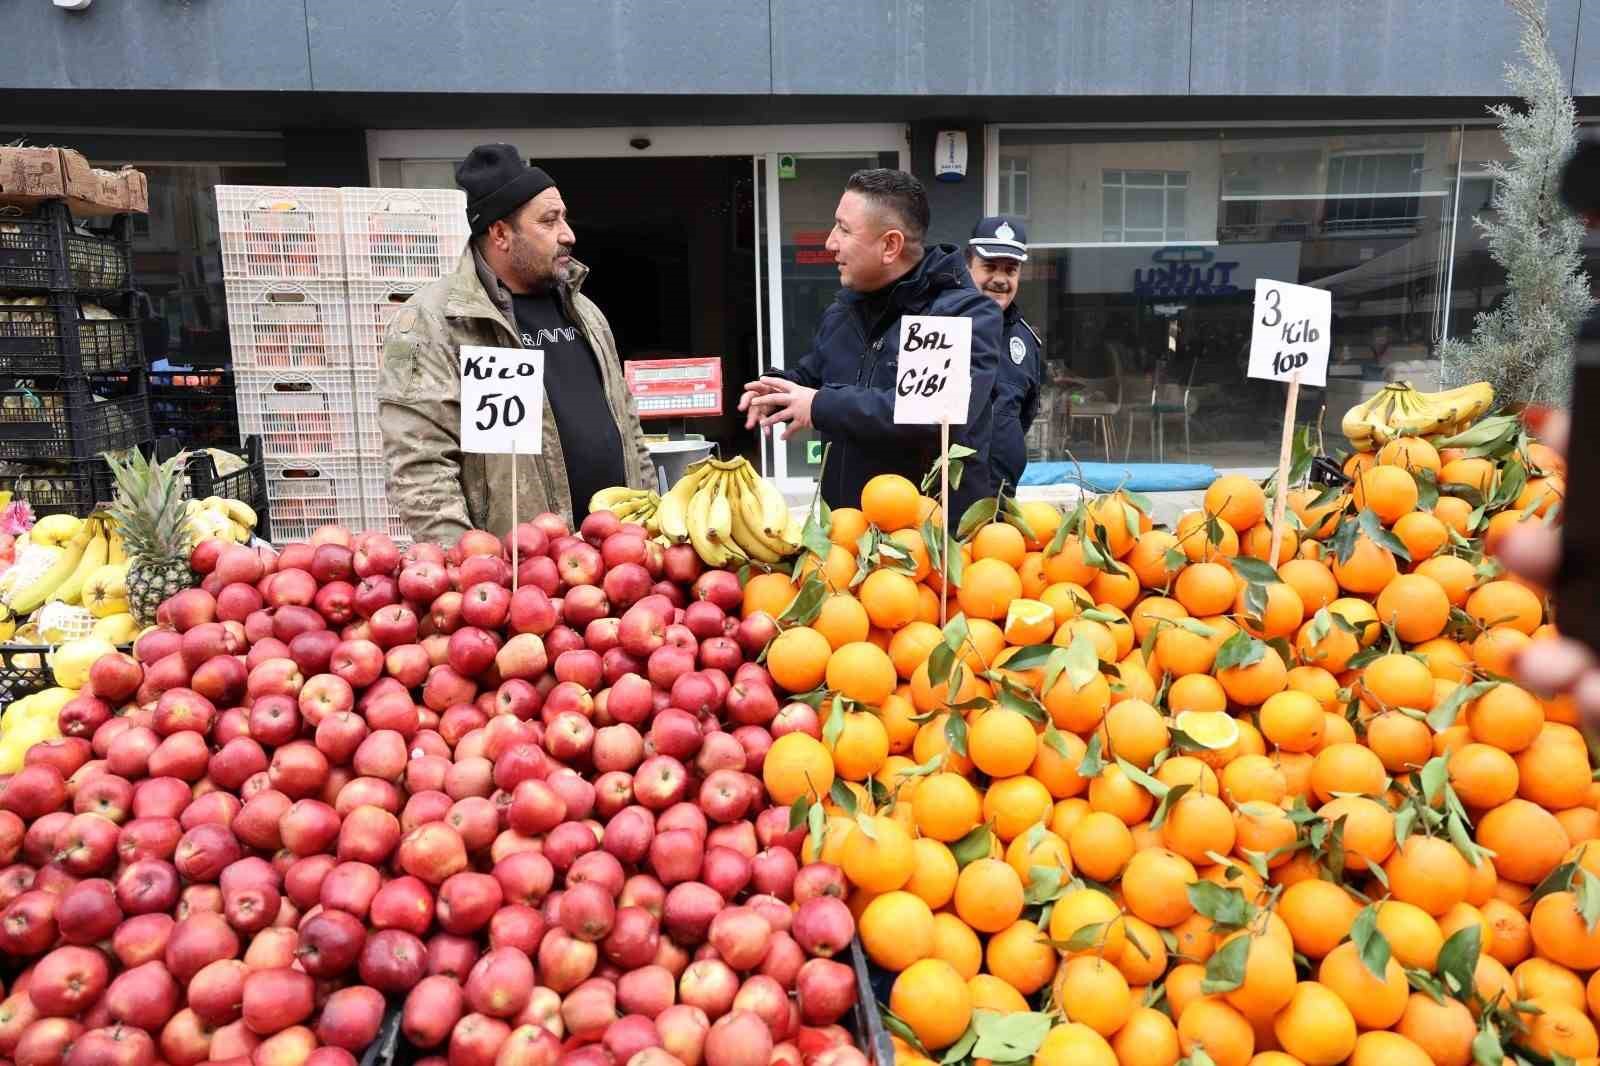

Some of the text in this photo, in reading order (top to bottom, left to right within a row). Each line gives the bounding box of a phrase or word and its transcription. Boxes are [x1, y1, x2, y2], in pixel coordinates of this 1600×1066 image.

[1262, 289, 1320, 345] 3 Kilo
[903, 322, 953, 353] BAL
[1272, 351, 1309, 376] 100
[475, 393, 526, 431] 50
